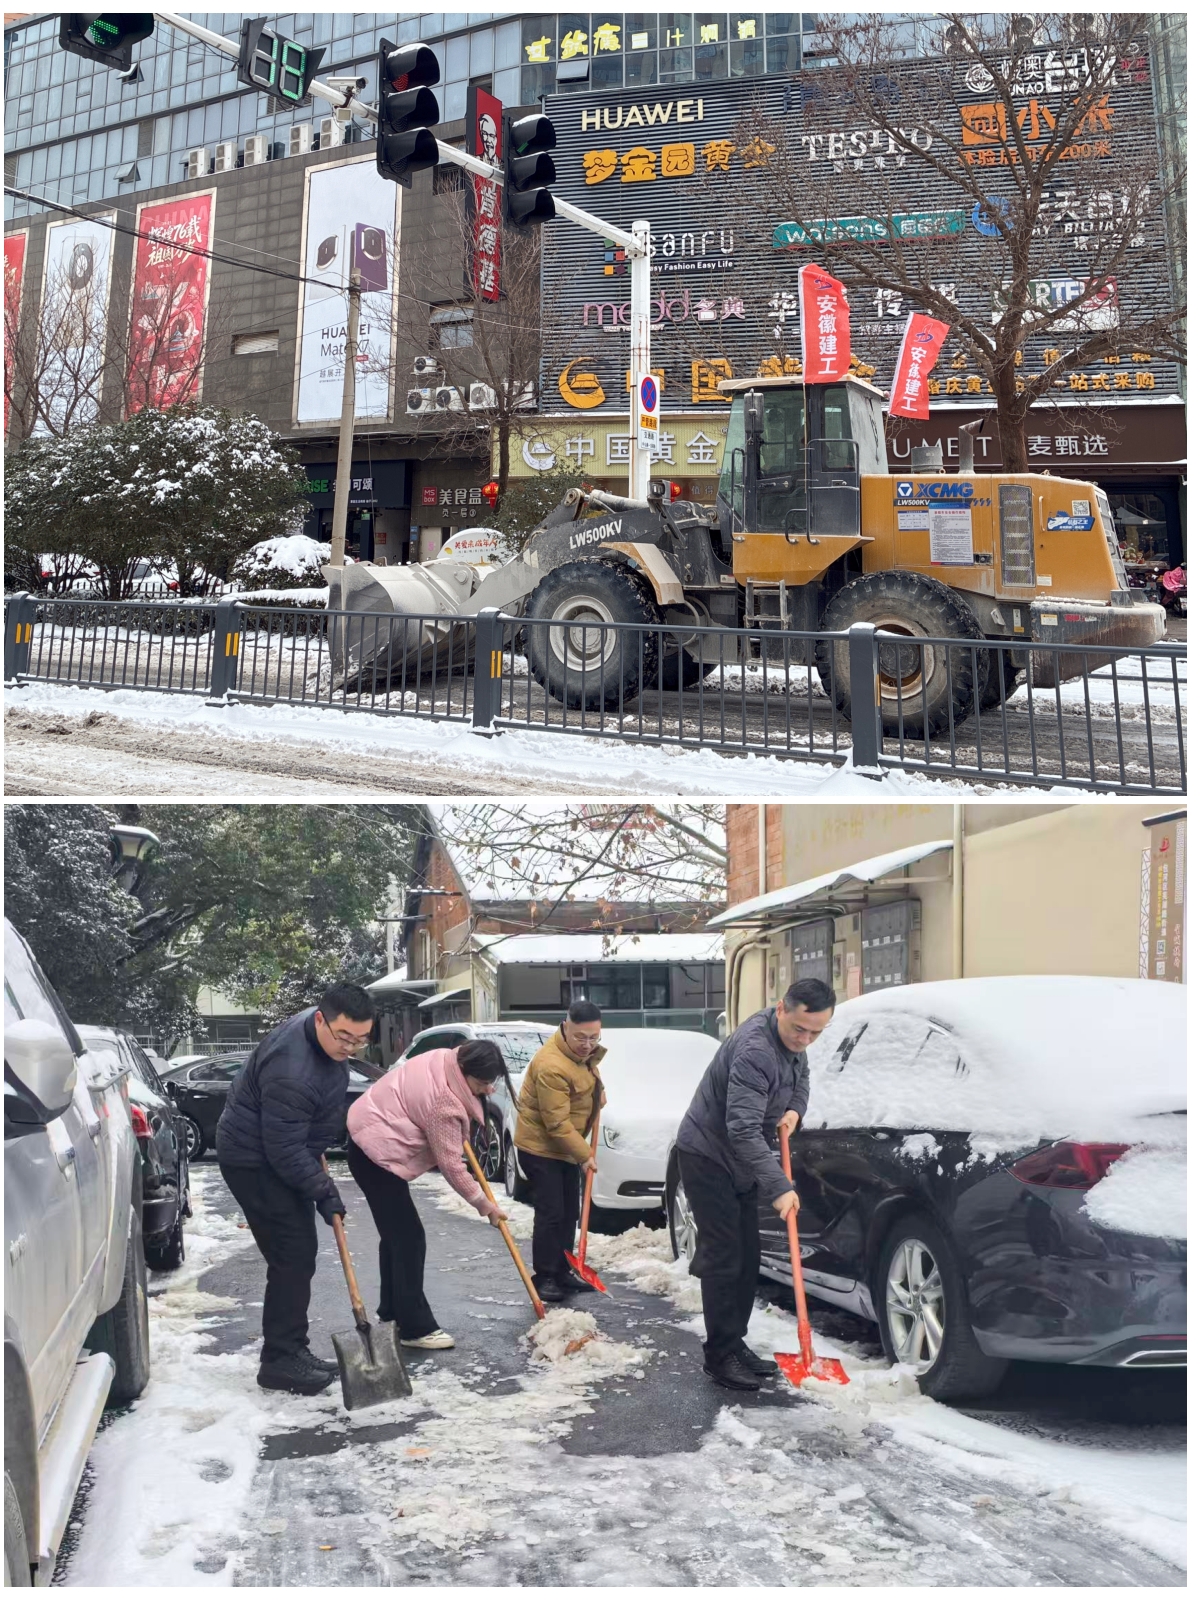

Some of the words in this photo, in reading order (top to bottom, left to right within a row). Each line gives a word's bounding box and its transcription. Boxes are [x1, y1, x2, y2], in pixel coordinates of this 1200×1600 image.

[582, 98, 705, 132] HUAWEI
[1016, 92, 1115, 140] 小米
[582, 136, 776, 185] 梦金园黄金
[664, 262, 696, 271] Fashion
[697, 260, 716, 271] Easy
[717, 260, 734, 268] Life
[693, 296, 746, 321] 名典
[321, 323, 371, 340] HUAEI
[816, 294, 839, 375] 安徽建工
[901, 345, 927, 412] 安徽建工
[565, 431, 720, 467] 中国黄金
[1028, 435, 1109, 457] 麦甄选
[439, 487, 491, 505] 美食盒
[914, 482, 974, 498] XCMG
[569, 519, 623, 550] LW500KV
